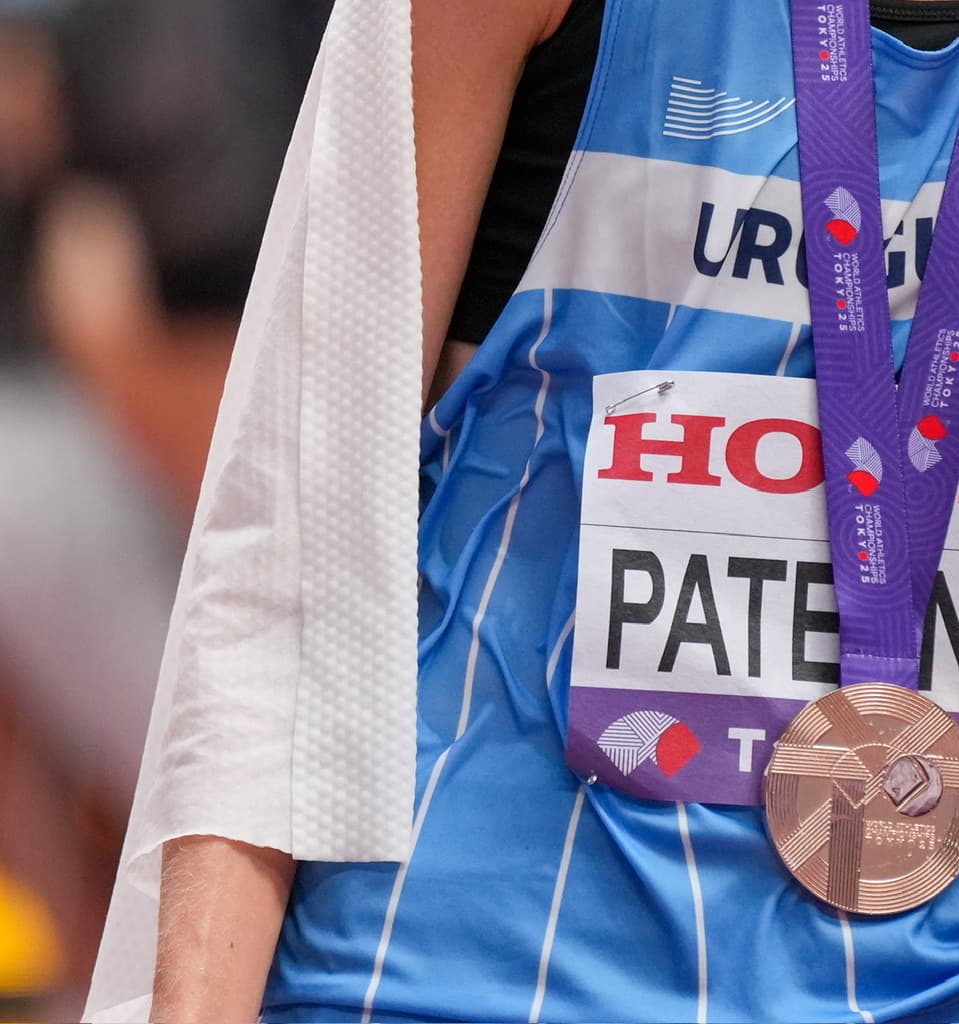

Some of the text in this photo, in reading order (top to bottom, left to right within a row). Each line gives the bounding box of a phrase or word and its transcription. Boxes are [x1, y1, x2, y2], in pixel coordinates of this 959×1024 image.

[826, 4, 839, 82] CHAMPIONSHIPS
[835, 5, 848, 82] WORLD ATHLETICS
[842, 252, 857, 332] CHAMPIONSHIPS
[852, 252, 865, 331] WORLD ATHLETICS
[923, 328, 947, 407] WORLD ATHLETICS
[930, 329, 955, 408] CHAMPIONSHIPS
[864, 504, 879, 584] CHAMPIONSHIPS
[873, 504, 887, 584] WORLD ATHLETICS
